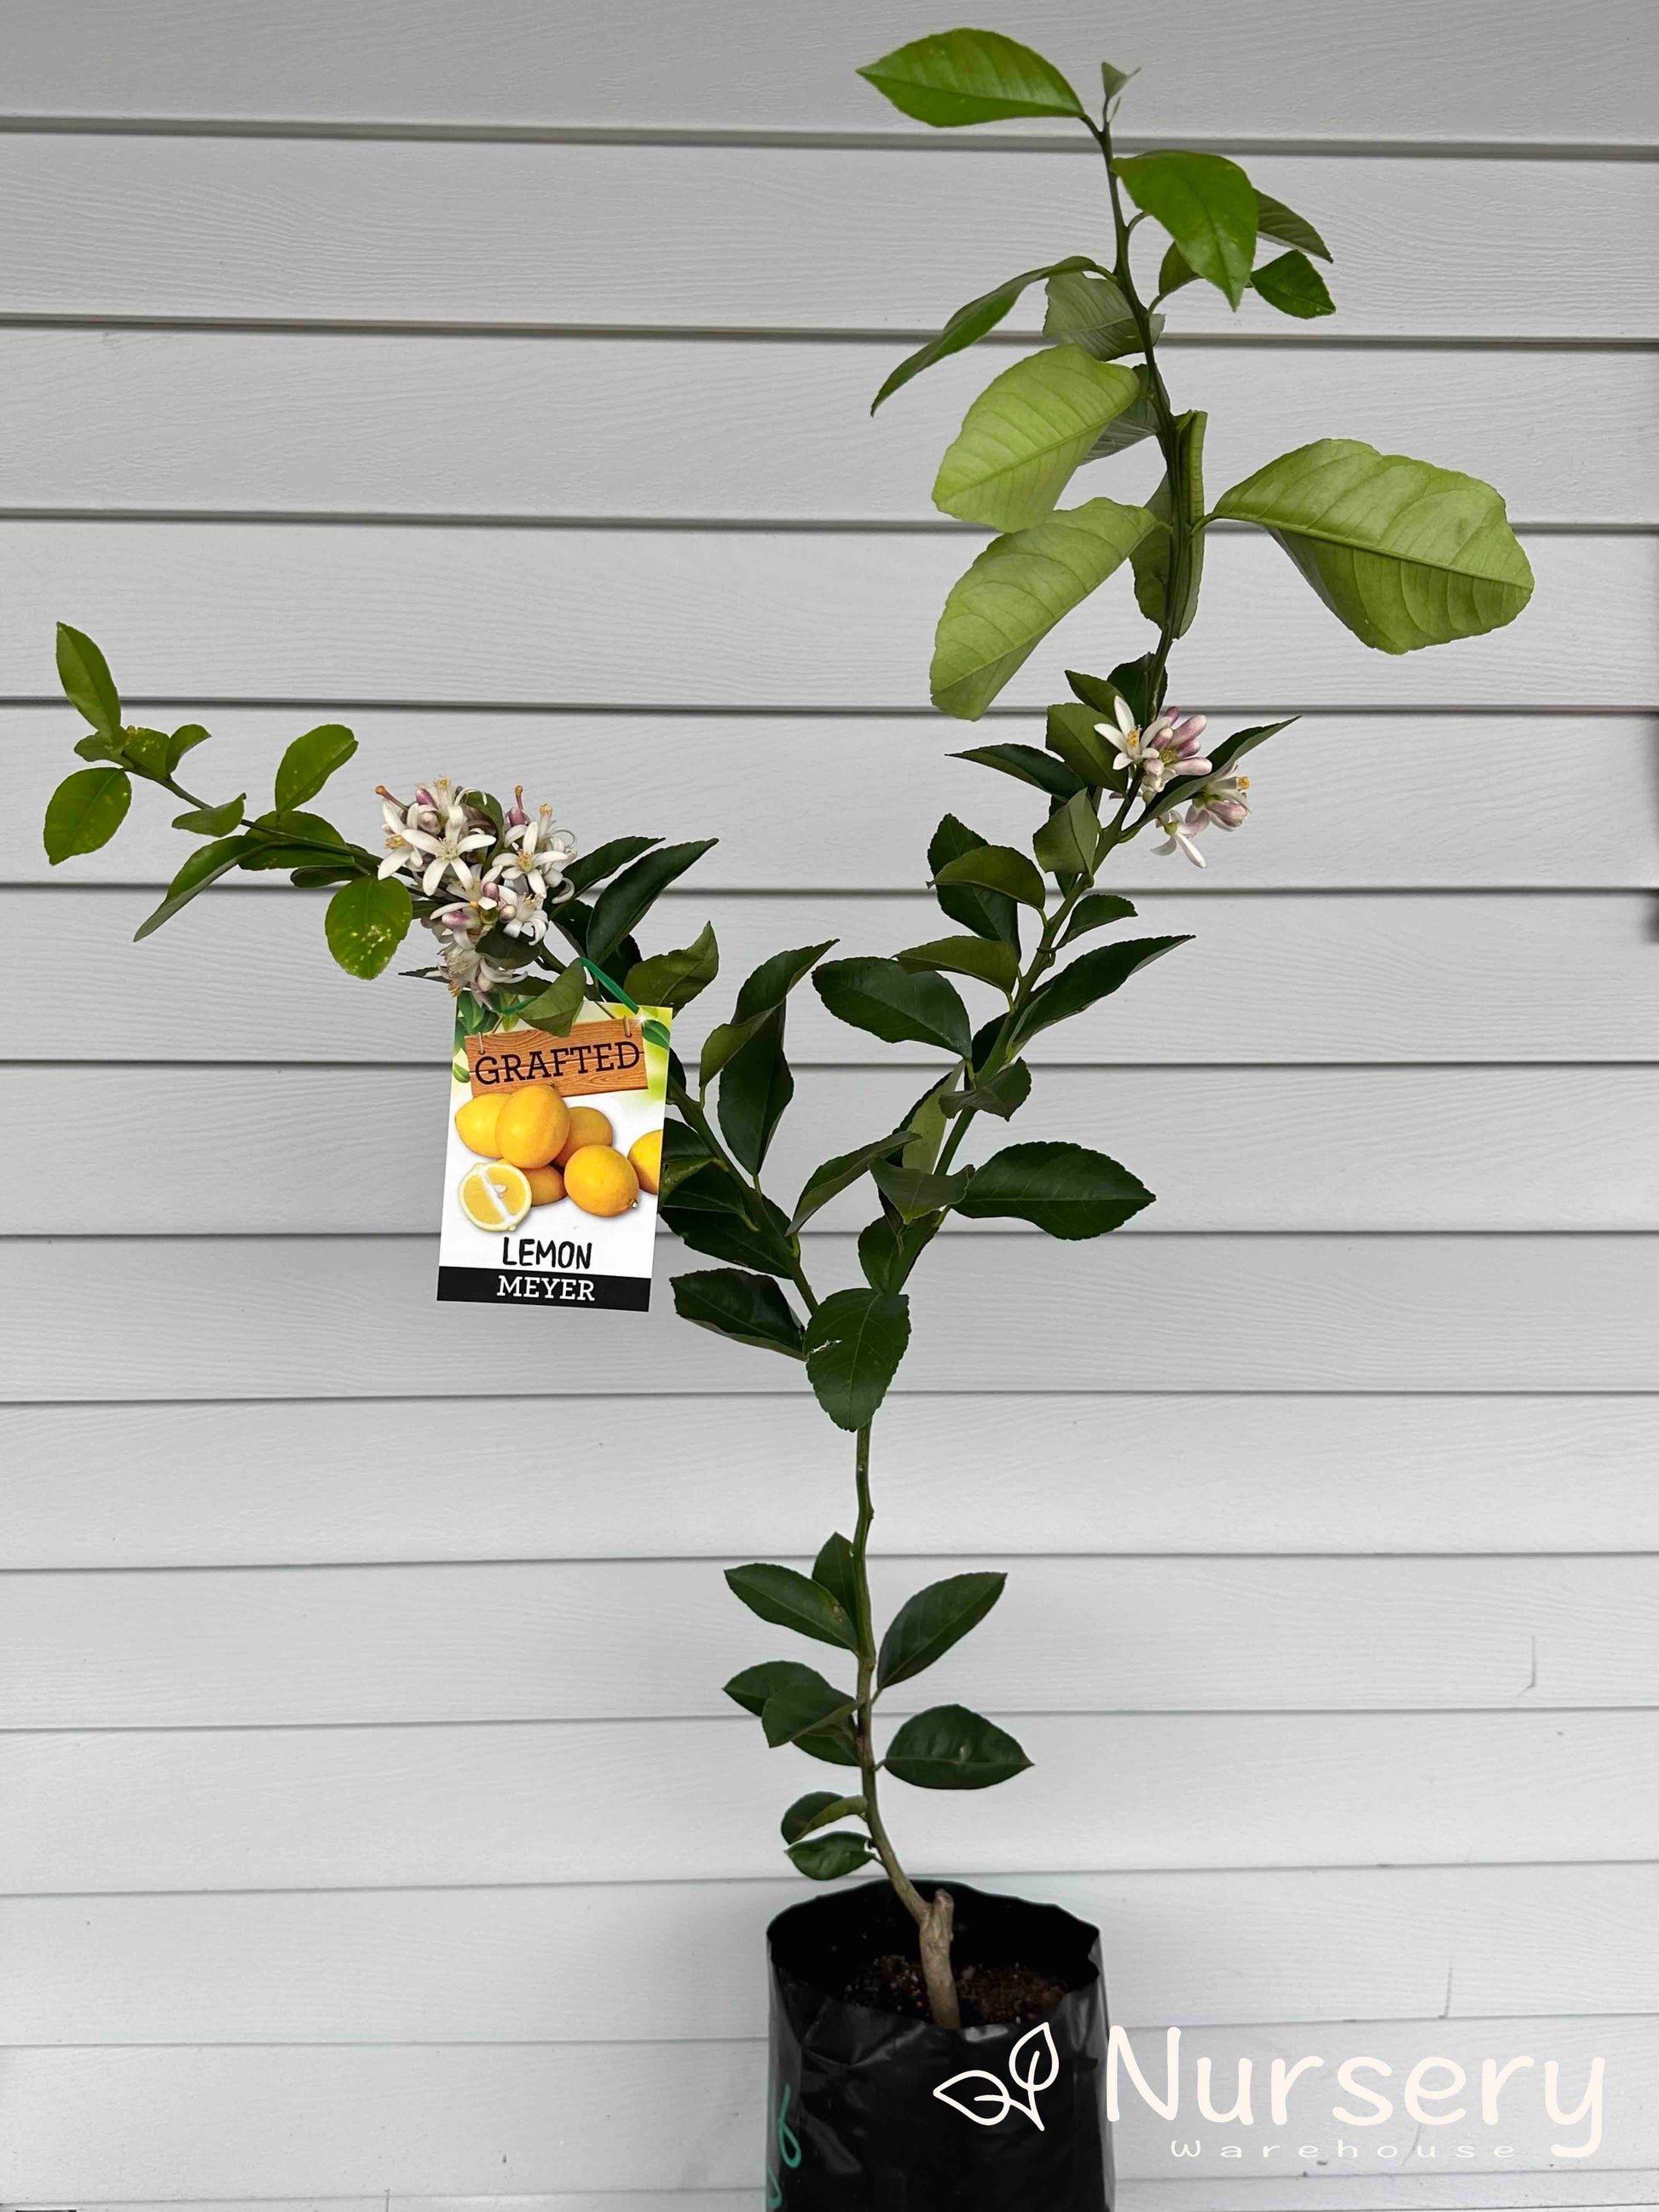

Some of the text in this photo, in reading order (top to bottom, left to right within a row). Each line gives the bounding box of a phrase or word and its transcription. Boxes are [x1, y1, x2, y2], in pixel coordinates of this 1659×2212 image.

[475, 1041, 640, 1085] GRAFTED
[502, 1237, 592, 1269] LEMON
[496, 1275, 596, 1302] MEYER
